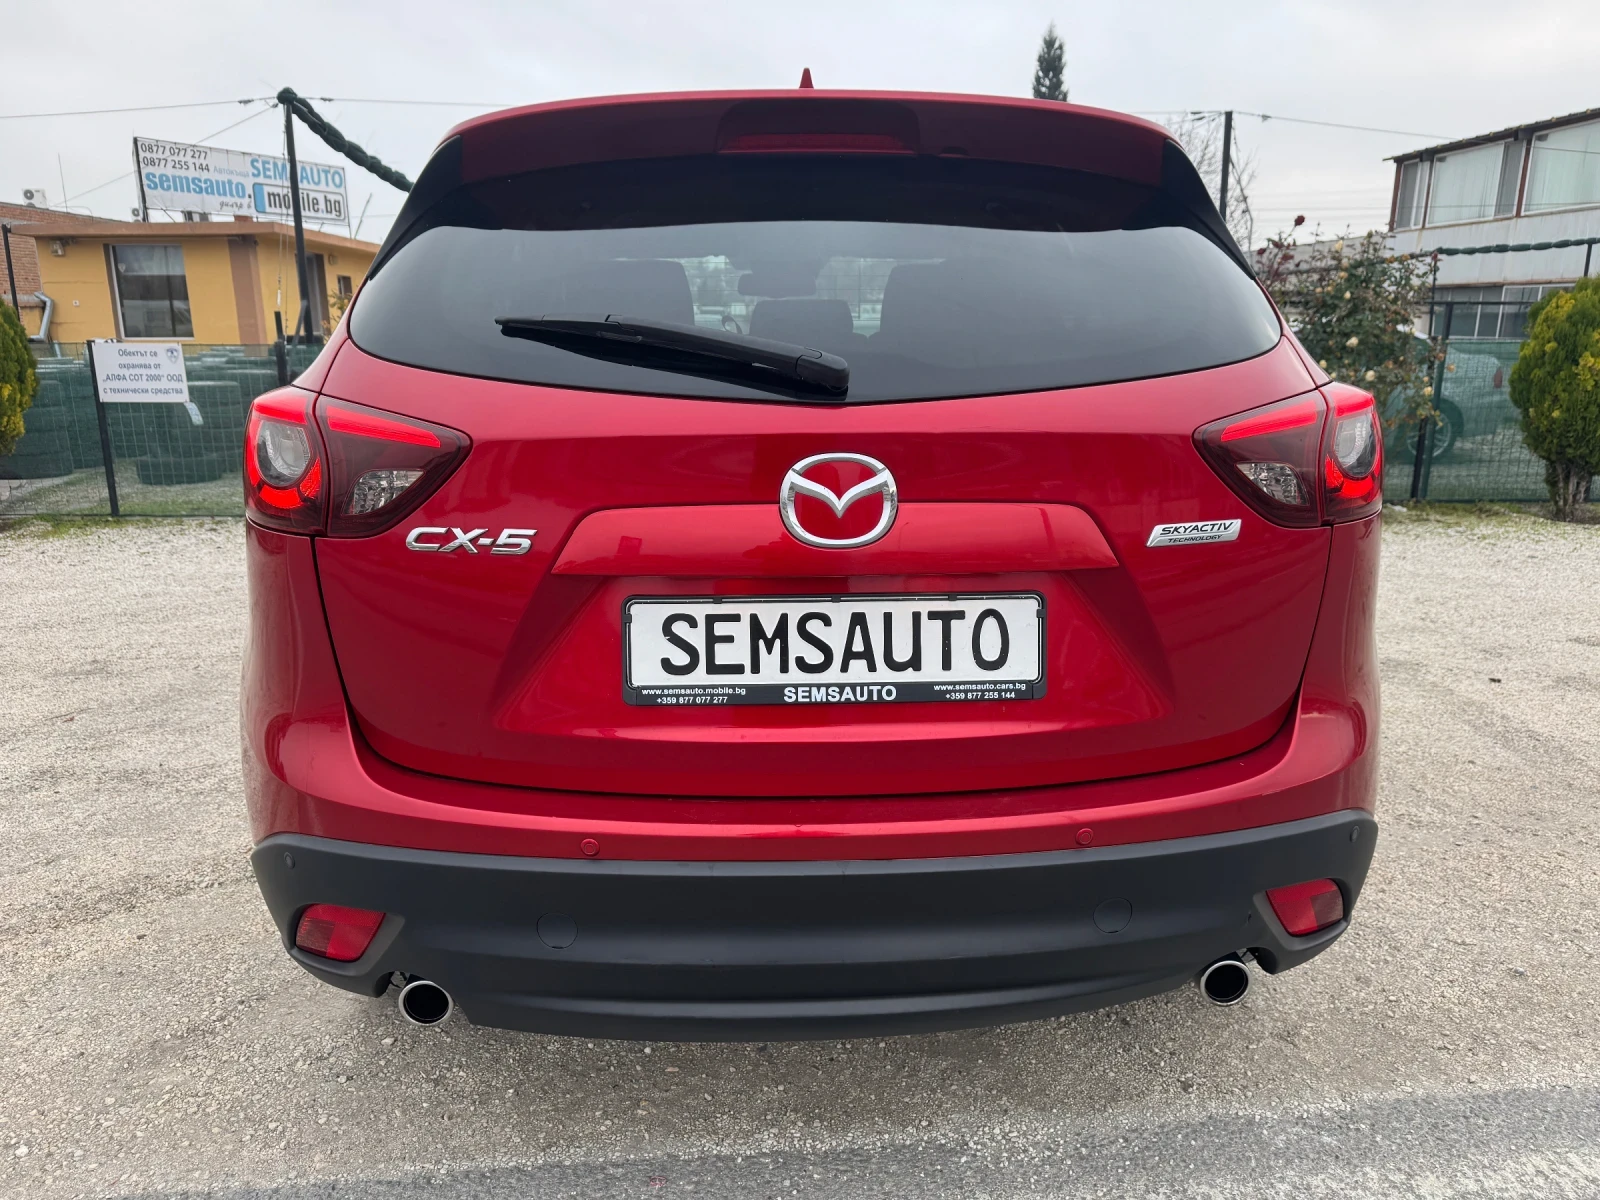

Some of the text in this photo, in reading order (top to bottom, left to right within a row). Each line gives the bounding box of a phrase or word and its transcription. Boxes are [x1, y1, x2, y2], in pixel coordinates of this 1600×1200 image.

[140, 143, 208, 160] 0877 077 277
[142, 156, 210, 172] 0877 255 144
[250, 157, 343, 188] SEMAUTO
[267, 191, 342, 217] moile.bg
[118, 349, 147, 357] Обектът
[118, 363, 152, 371] охранява
[128, 374, 144, 382] СОТ
[166, 374, 184, 383] ООД
[1160, 521, 1234, 535] SKYACTIV
[405, 526, 538, 555] CX-5
[1168, 534, 1223, 543] TECHNOLOGY
[660, 608, 1010, 675] SEMSAUTO
[641, 687, 746, 695] www.semsauto.mobile.bg
[783, 685, 897, 702] SEMSAUTO
[933, 682, 1026, 690] www.semsauto.cars.bg
